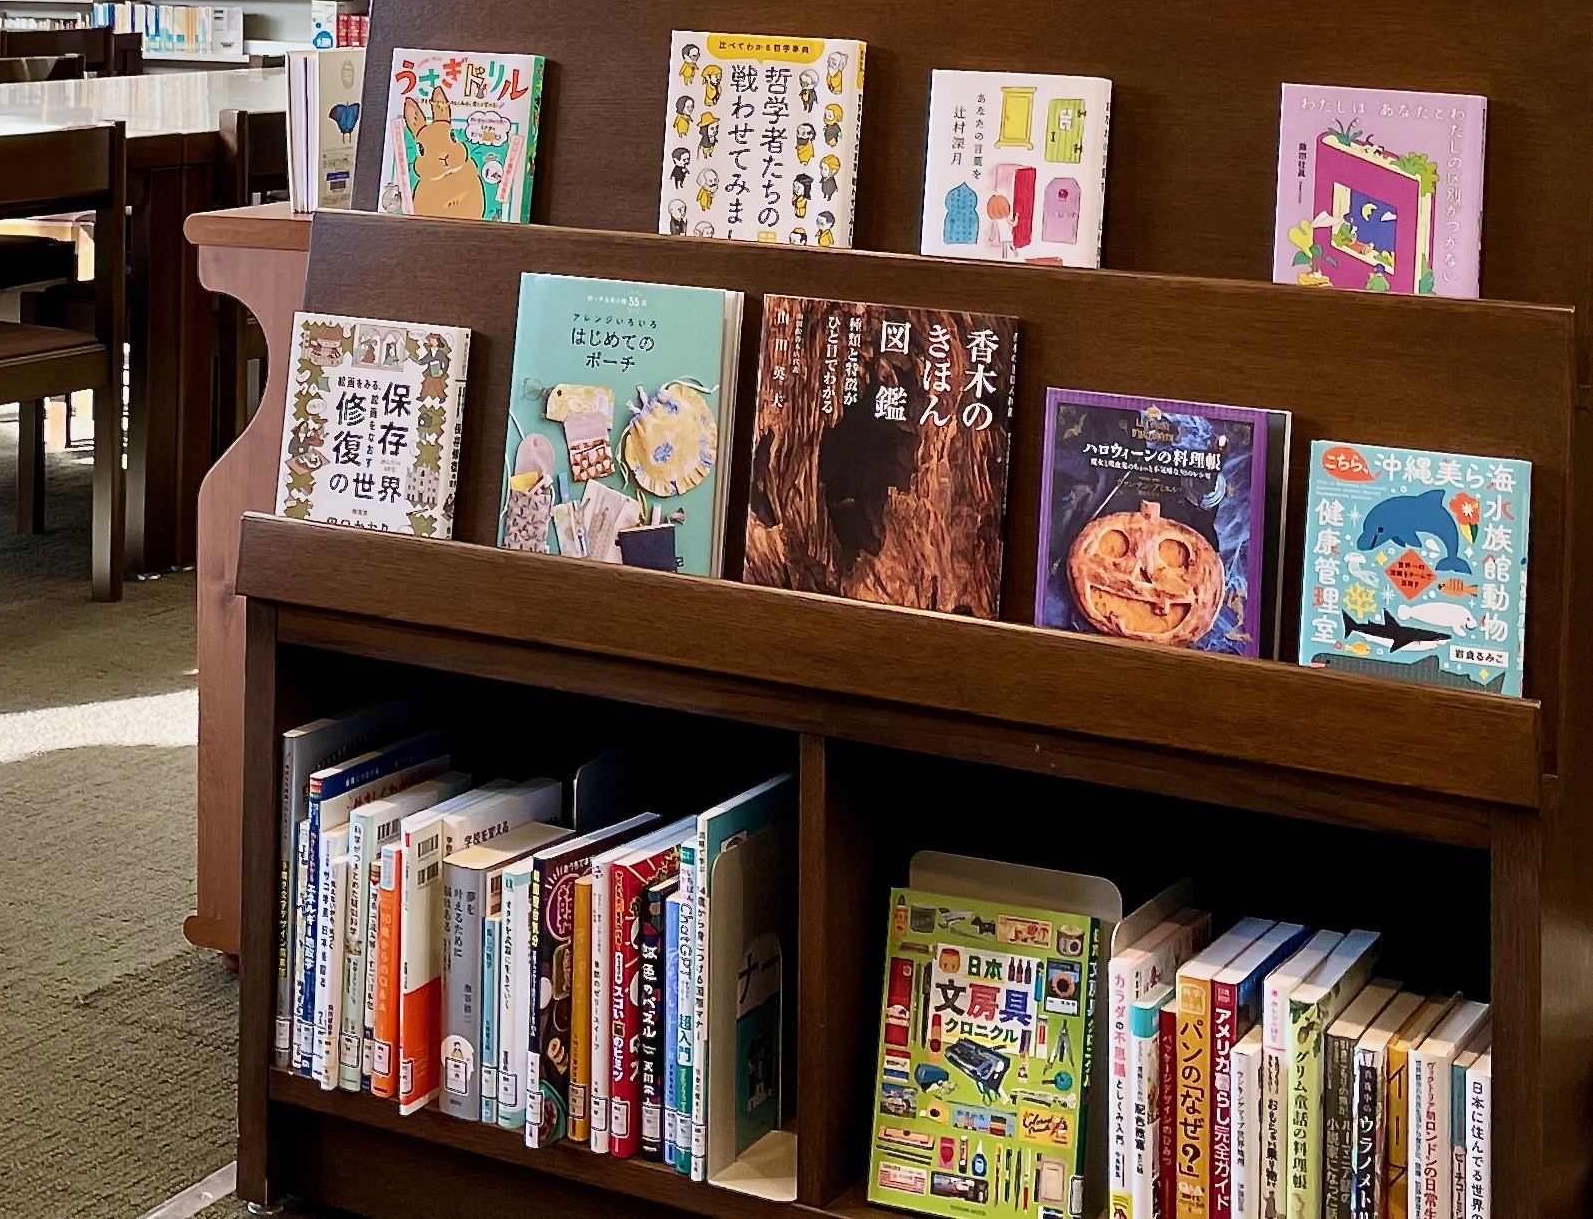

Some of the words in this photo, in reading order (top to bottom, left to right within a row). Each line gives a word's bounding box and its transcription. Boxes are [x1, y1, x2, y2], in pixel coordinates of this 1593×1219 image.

[395, 57, 529, 101] うさぎドリル
[757, 66, 793, 228] 哲学者たちの
[950, 106, 967, 166] 辻村深月
[972, 94, 986, 180] あなたの言葉を
[571, 327, 655, 352] はじめての
[585, 352, 636, 373] ポーチ
[821, 316, 841, 415] ひと目でわかる
[843, 317, 863, 406] 種類と特徴が
[874, 320, 912, 422] 図鑑
[919, 324, 952, 427] きほん
[962, 328, 1000, 431] 香木の
[333, 391, 367, 467] 修復
[378, 382, 411, 457] 保存
[330, 472, 402, 503] の世界
[1082, 443, 1221, 472] ハロウィーンの料理帳
[1374, 454, 1517, 493] 沖縄美ら海
[1310, 498, 1345, 645] 健康管理室
[1481, 494, 1514, 643] 水族館動物
[679, 902, 694, 981] ChatGPT
[967, 955, 1003, 980] 日本
[679, 1014, 692, 1063] 超入門
[933, 978, 1033, 1026] 文房具
[945, 1017, 1019, 1043] クロニクル
[1292, 1050, 1310, 1190] グリム童話の料理帳
